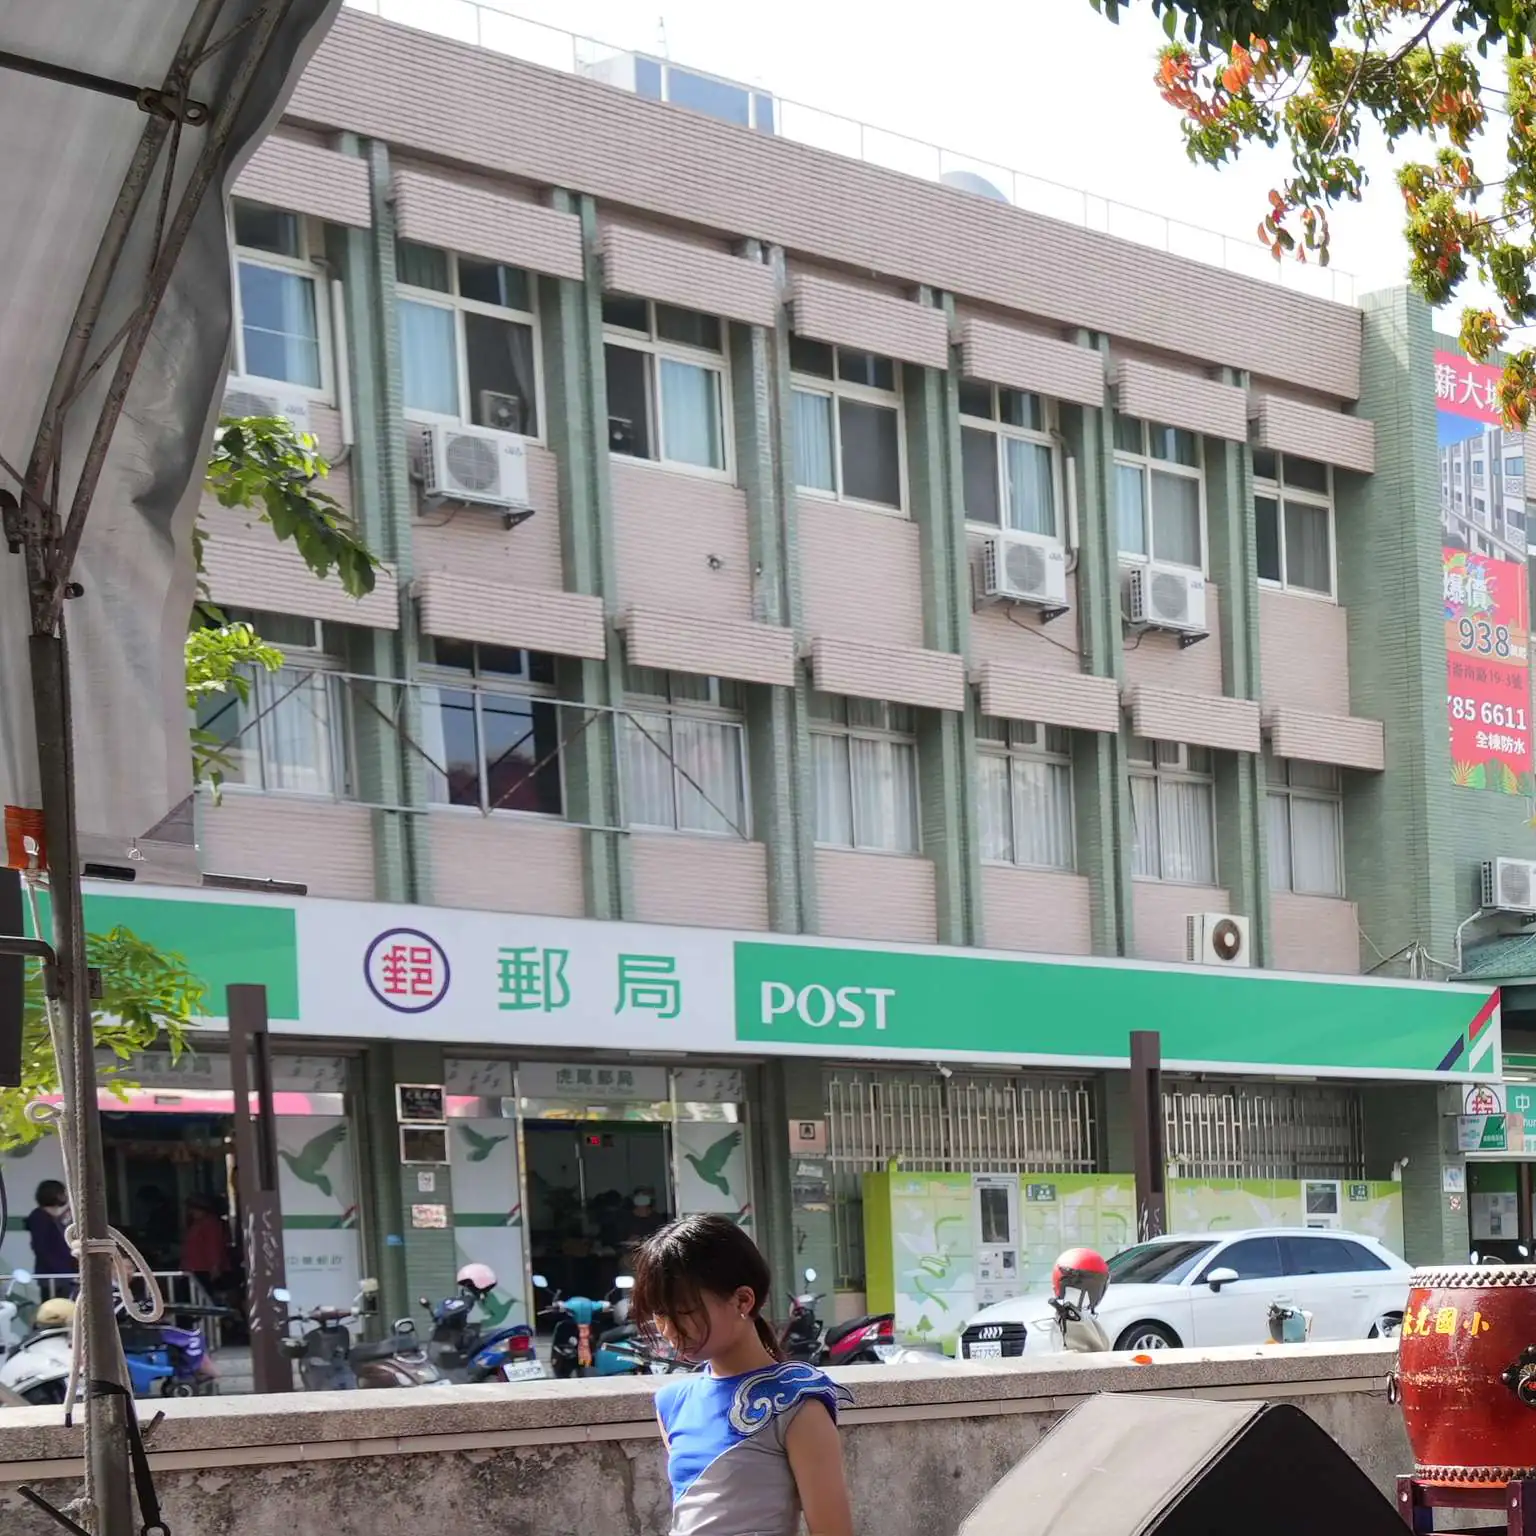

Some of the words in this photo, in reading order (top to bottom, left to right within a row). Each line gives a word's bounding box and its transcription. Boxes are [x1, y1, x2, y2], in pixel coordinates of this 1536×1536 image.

[1459, 617, 1511, 660] 938
[1448, 696, 1476, 722] 85
[1481, 702, 1527, 729] 6611
[497, 945, 682, 1019] 郵局
[760, 981, 897, 1030] POST
